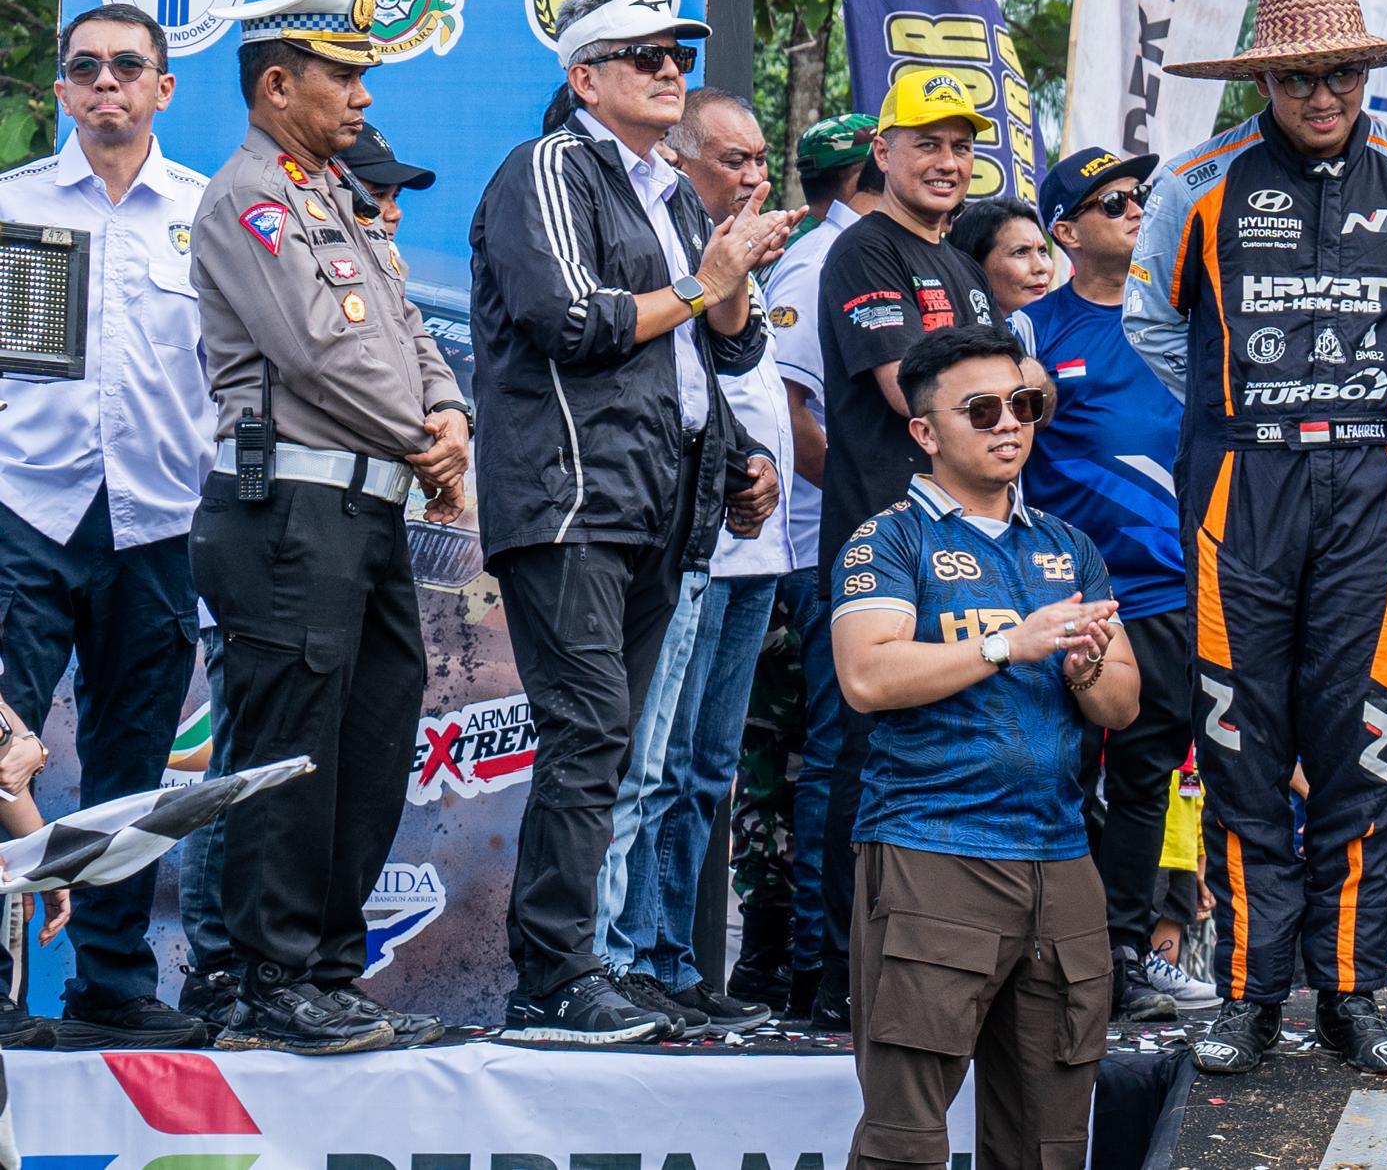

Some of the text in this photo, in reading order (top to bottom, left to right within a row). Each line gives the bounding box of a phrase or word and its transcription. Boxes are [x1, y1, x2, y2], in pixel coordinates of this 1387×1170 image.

[169, 15, 219, 43] INDONES
[399, 26, 434, 50] UTARA
[1185, 163, 1219, 187] OMP
[1237, 216, 1303, 230] HYUNDAI
[1237, 228, 1302, 239] MOTORSPORT
[1241, 240, 1298, 251] Customer Racing
[1355, 348, 1385, 362] BMB2
[1242, 382, 1368, 407] TURBO
[1256, 425, 1282, 441] OM
[843, 544, 874, 569] SS
[931, 549, 982, 582] SS
[843, 573, 877, 597] SS
[464, 702, 533, 735] ARMO
